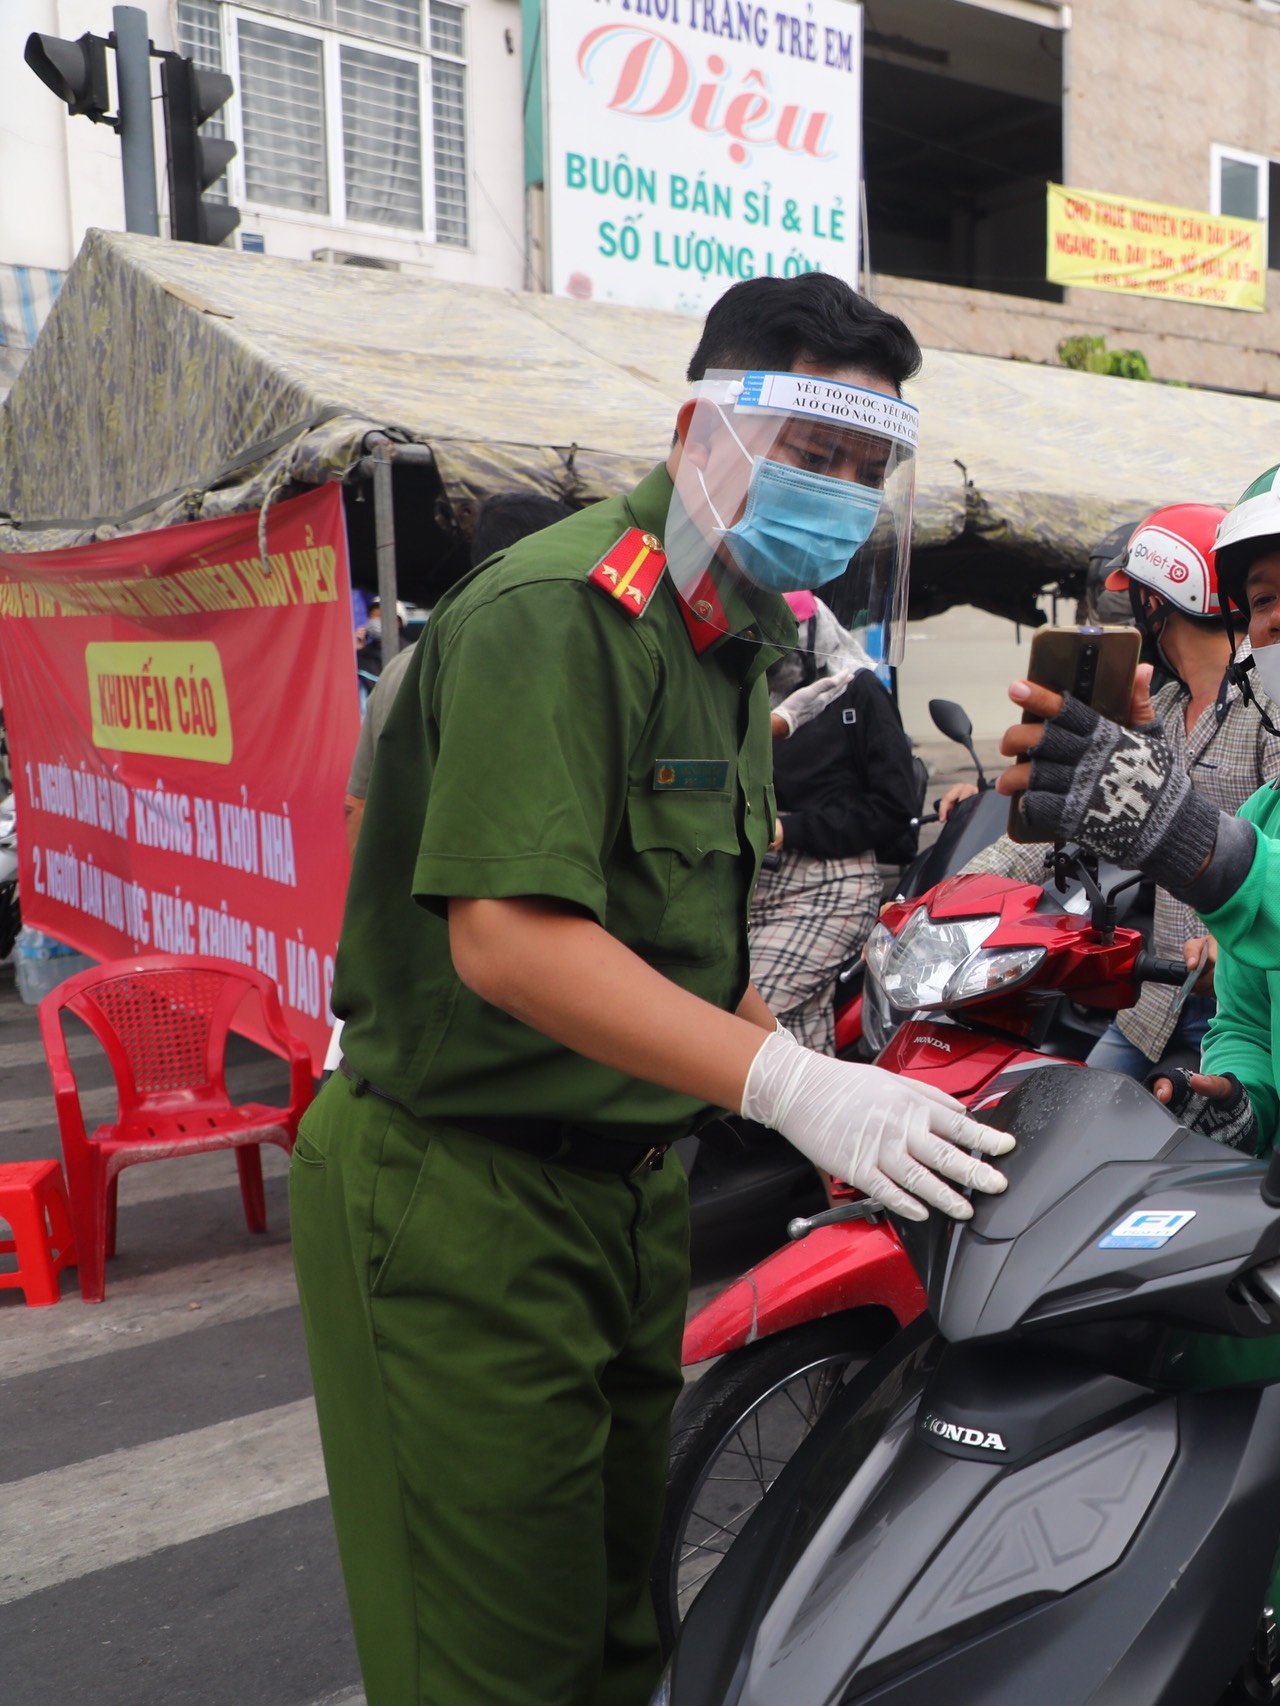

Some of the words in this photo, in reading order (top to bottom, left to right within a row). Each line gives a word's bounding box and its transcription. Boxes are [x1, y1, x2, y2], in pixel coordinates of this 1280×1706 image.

[776, 3, 816, 62] TRẺ
[824, 27, 853, 72] EM
[577, 23, 836, 166] Diệu
[565, 152, 656, 204] BUÔN
[670, 171, 732, 219] BÁN
[782, 199, 801, 233] &
[813, 197, 846, 242] LẺ
[599, 213, 644, 261] SỐ
[655, 230, 754, 281] LƯỢNG
[796, 381, 821, 396] YÊU
[97, 656, 172, 733] KHUYẾN
[174, 663, 217, 738] CÁO
[25, 761, 40, 810] 1.
[132, 778, 193, 857] KHÔNG
[194, 796, 219, 863] RA
[219, 784, 259, 875] KHỎI
[260, 801, 298, 888] NHÀ
[33, 845, 45, 894] 2.
[151, 885, 195, 956] KHÁC
[198, 900, 253, 967] KHÔNG
[285, 928, 320, 1020] VÀO
[913, 1036, 951, 1052] HONDA
[1130, 1215, 1184, 1227] FI
